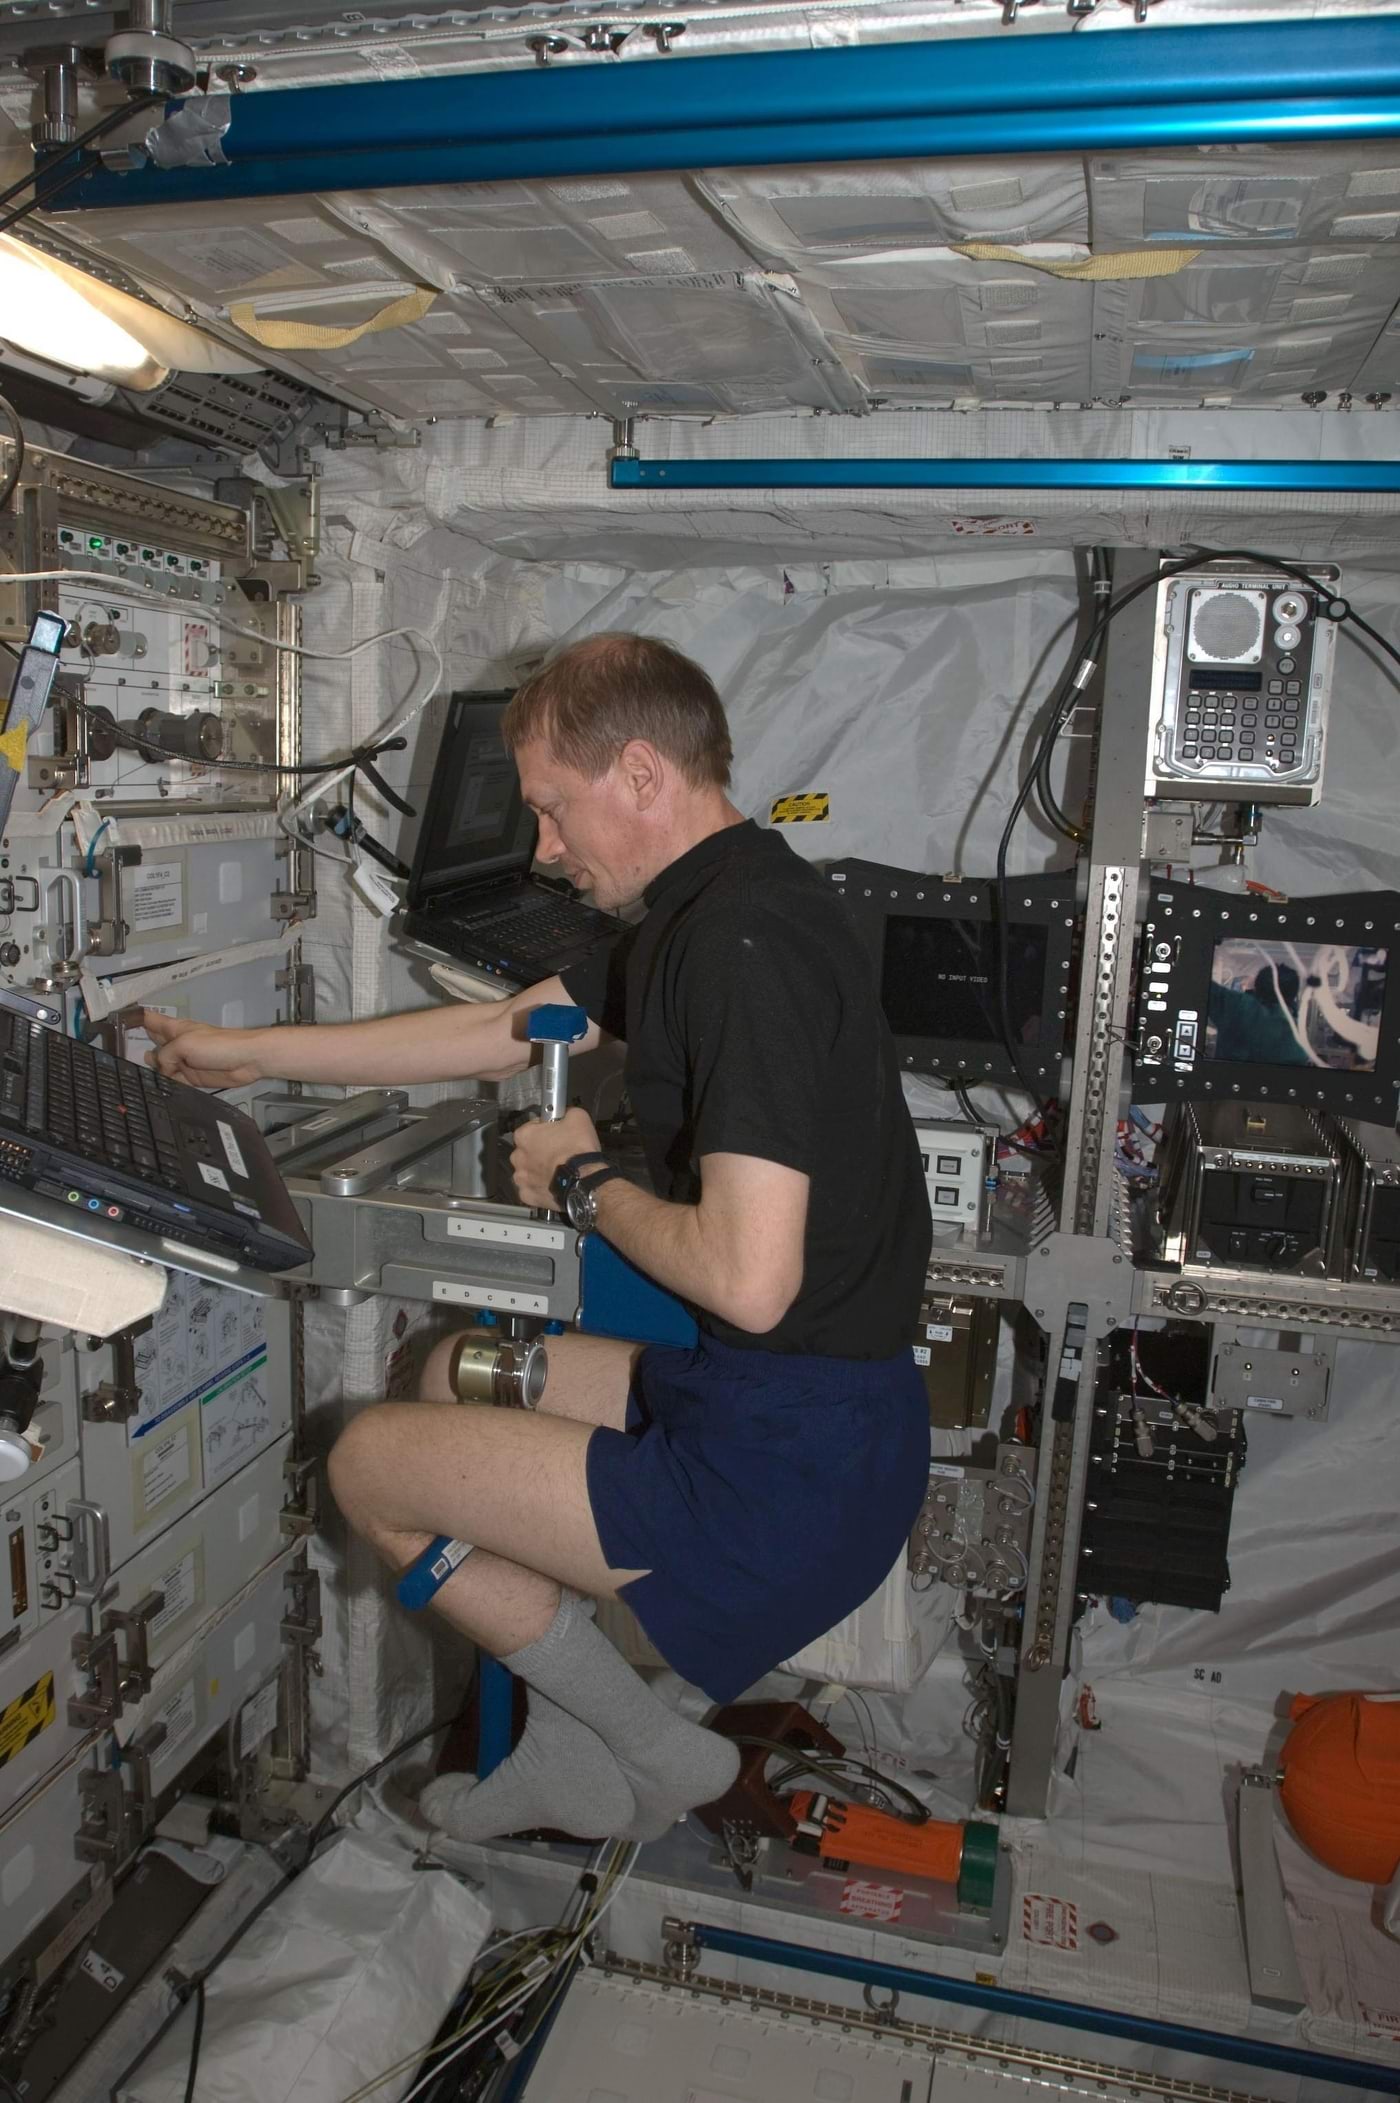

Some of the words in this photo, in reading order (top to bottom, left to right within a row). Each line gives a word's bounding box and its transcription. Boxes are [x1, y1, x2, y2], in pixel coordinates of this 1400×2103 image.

[442, 1287, 447, 1295] E
[1194, 1668, 1205, 1681] SC
[1046, 1904, 1054, 1919] FIRE
[1046, 1921, 1054, 1940] PORT
[83, 1958, 93, 1973] F
